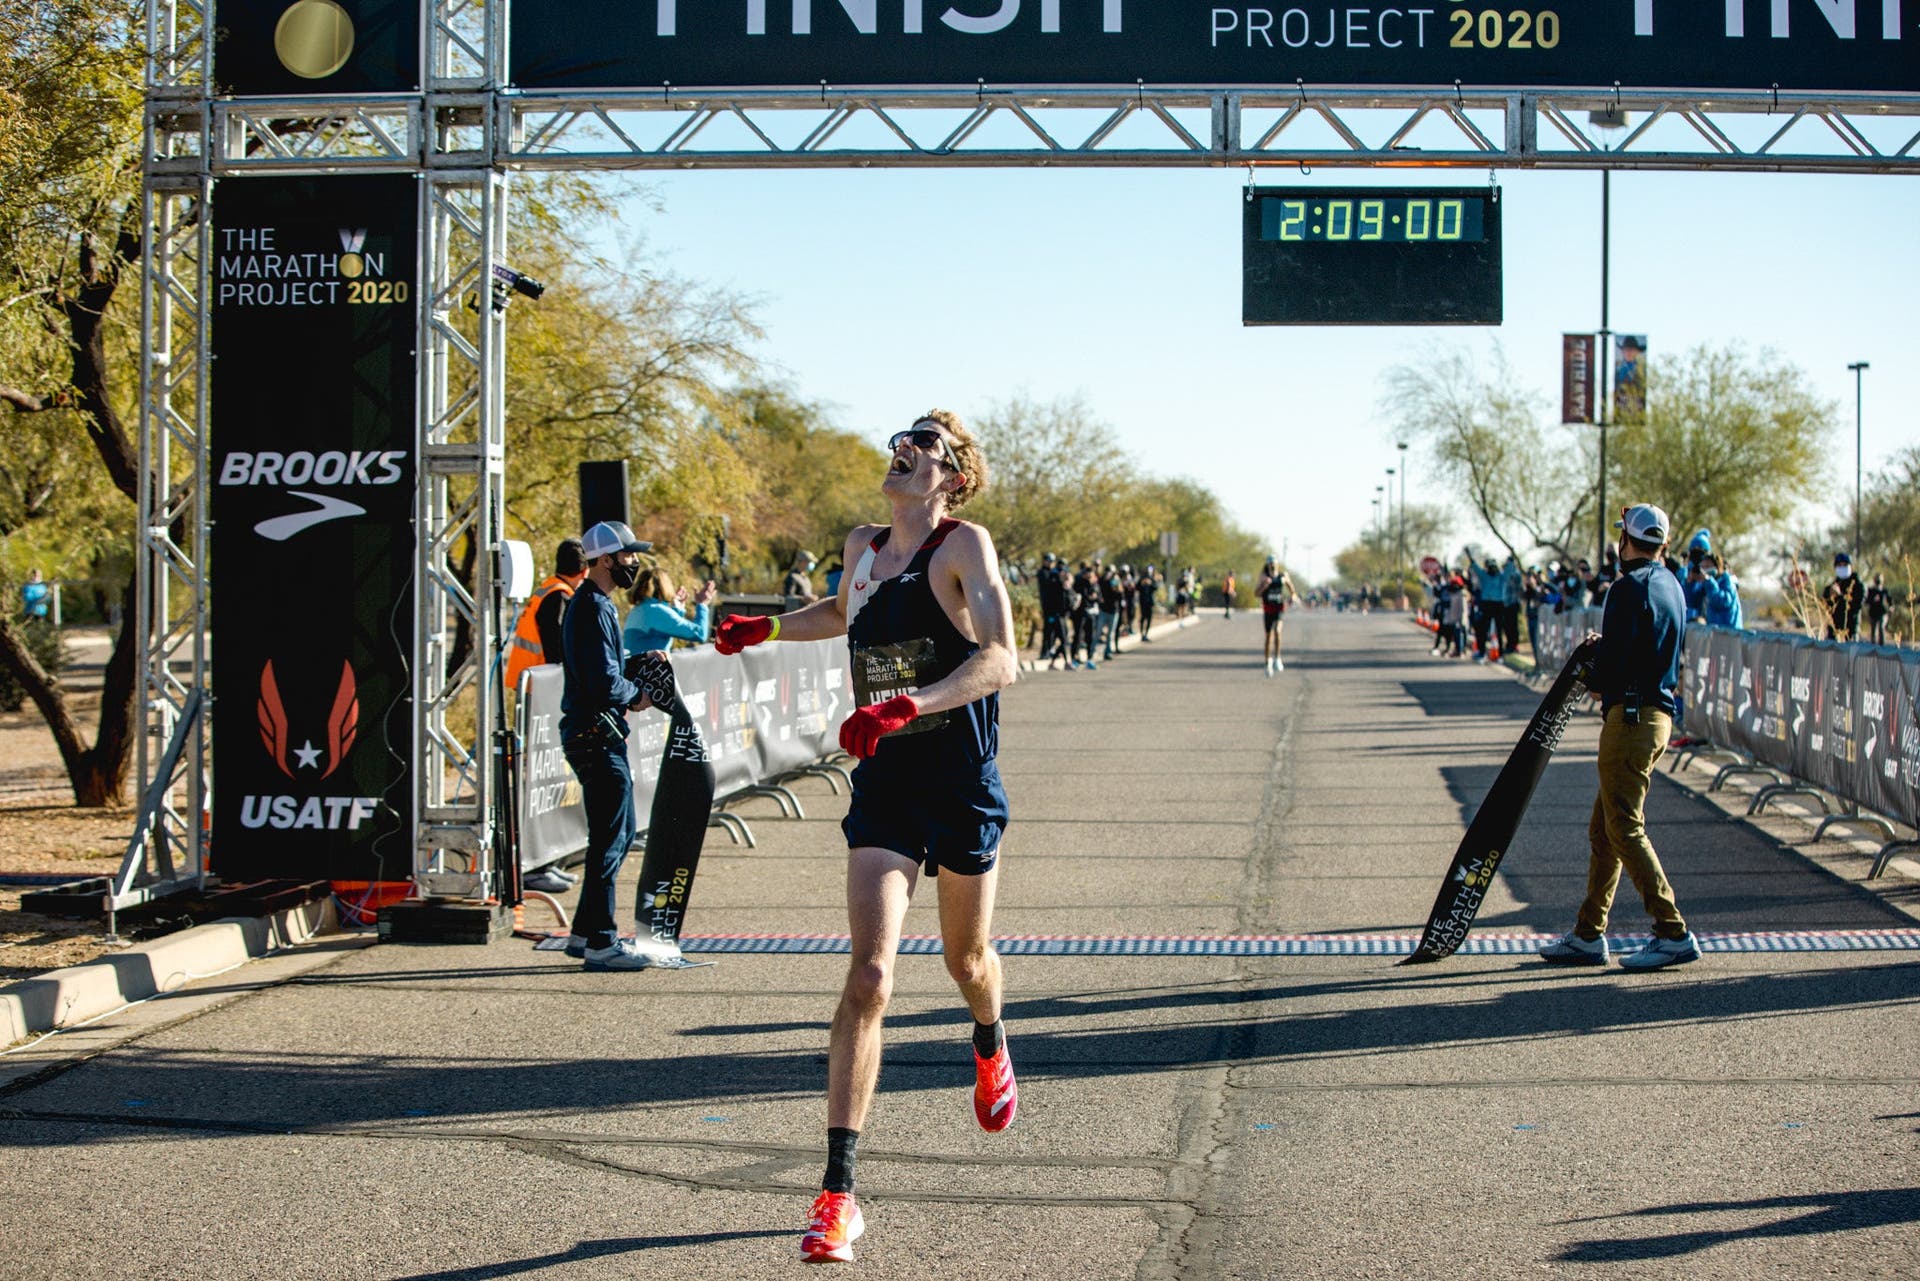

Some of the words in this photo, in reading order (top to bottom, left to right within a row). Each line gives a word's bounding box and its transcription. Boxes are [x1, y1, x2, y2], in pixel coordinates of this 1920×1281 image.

[1211, 9, 1434, 48] PROJECT
[1450, 9, 1560, 49] 2020
[222, 228, 275, 251] THE
[220, 252, 384, 279] MARATHON
[220, 282, 340, 305] PROJECT
[347, 281, 408, 304] 2020
[218, 450, 407, 486] BROOKS
[649, 657, 675, 686] THE
[866, 656, 879, 667] THE
[867, 671, 898, 683] PROJECT
[1529, 710, 1556, 741] THE
[669, 725, 691, 759] THE
[239, 795, 384, 830] USATF
[669, 867, 689, 904] 2020
[1431, 857, 1483, 956] MARATHON
[1440, 888, 1483, 957] PROJECT
[1477, 850, 1500, 887] 2020
[1423, 918, 1446, 950] THE
